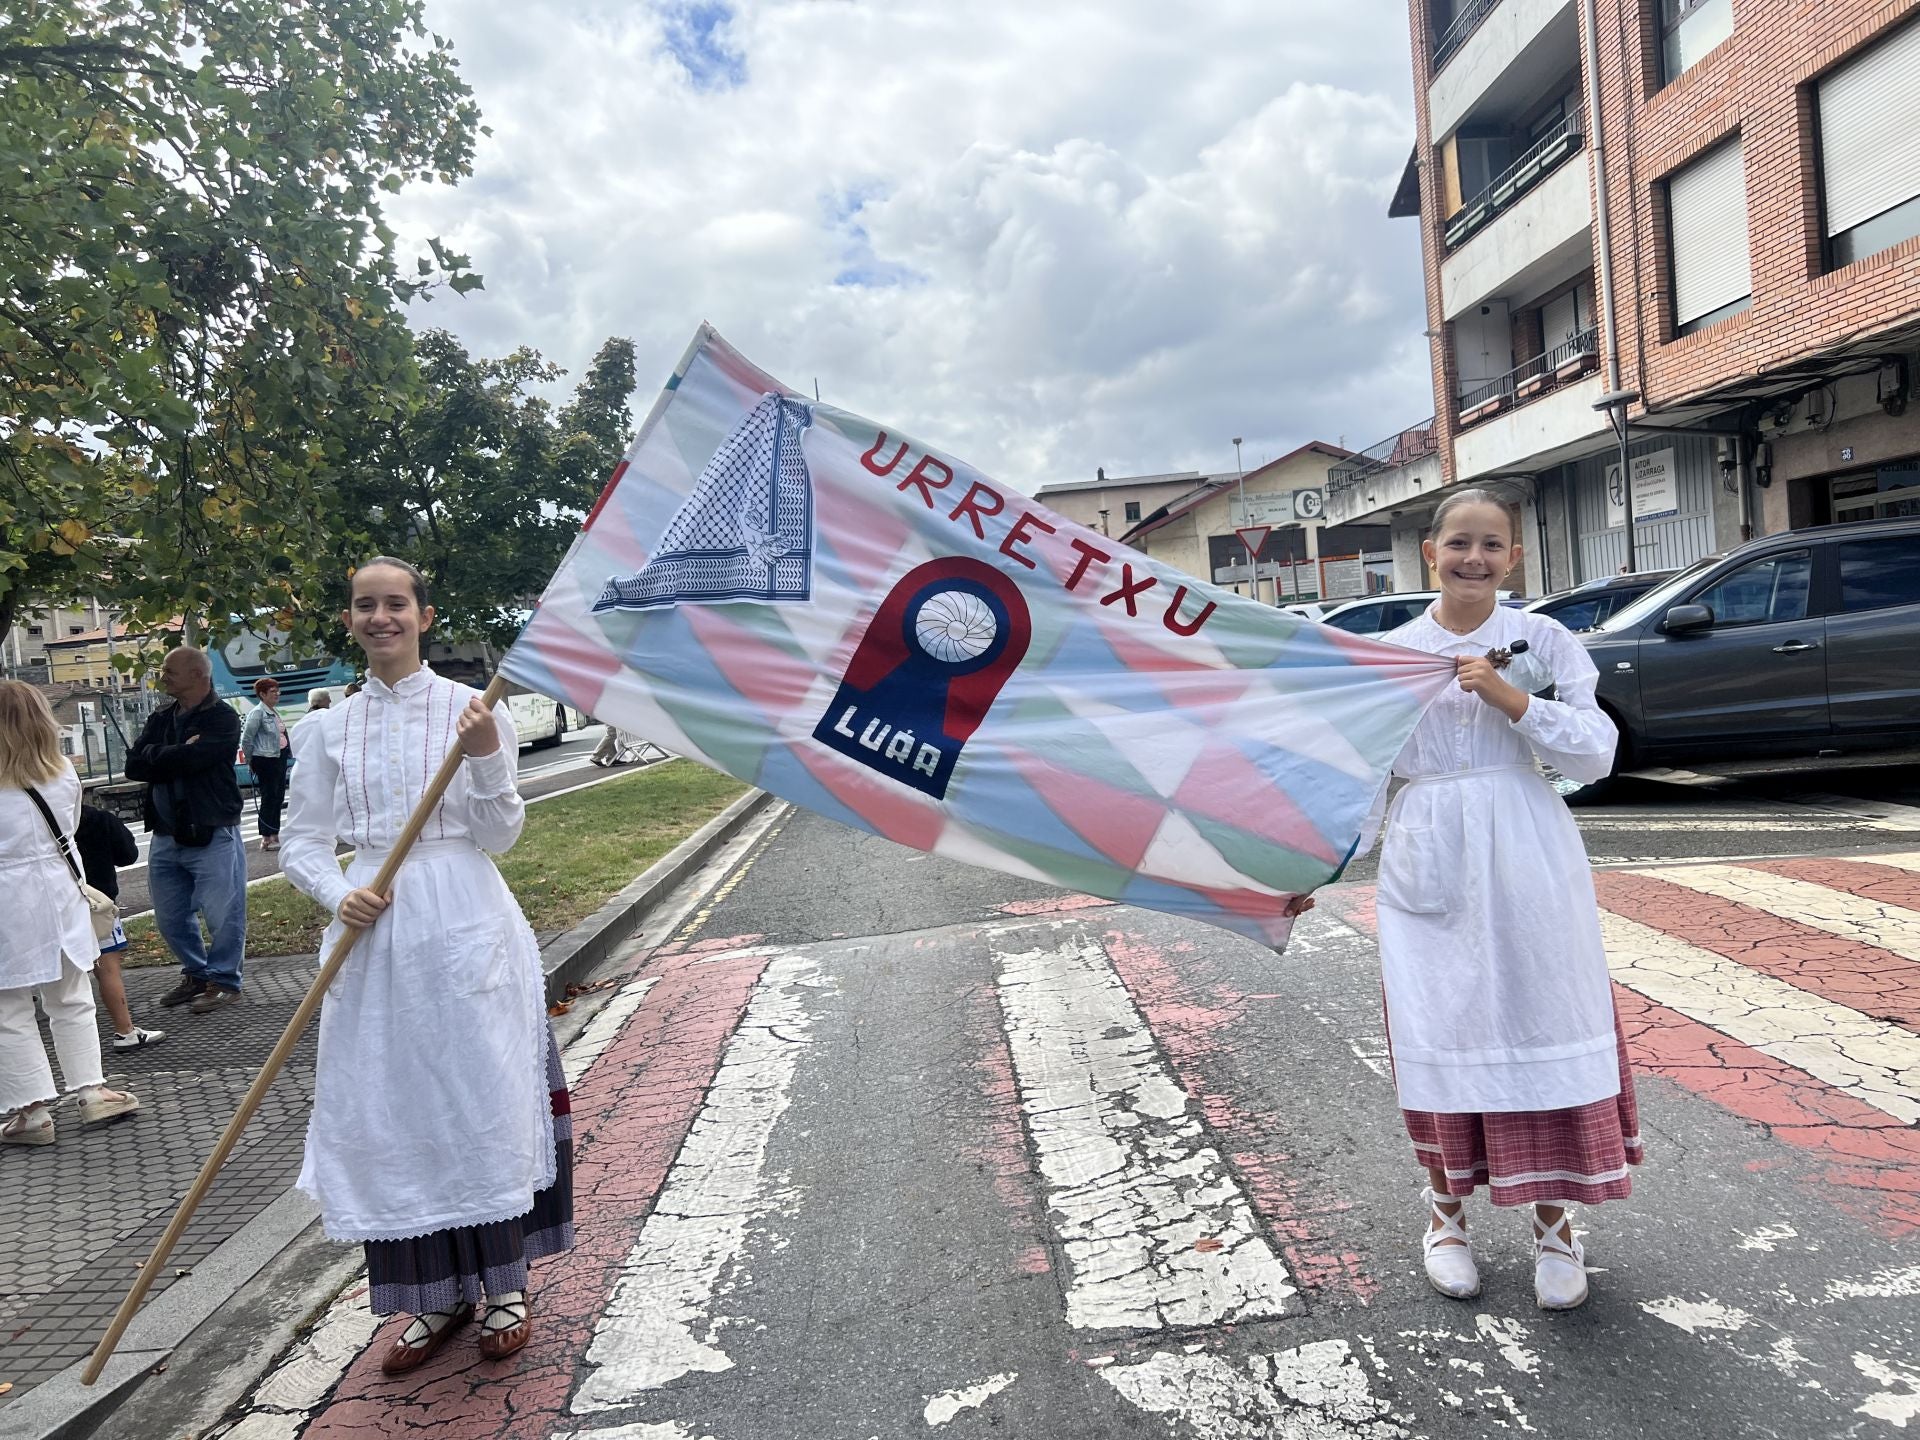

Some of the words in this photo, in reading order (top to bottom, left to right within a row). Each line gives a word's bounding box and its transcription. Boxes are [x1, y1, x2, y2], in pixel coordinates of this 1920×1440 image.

[1635, 458, 1650, 470] AITOR
[1635, 464, 1665, 479] LIZARRAGA
[860, 431, 1217, 637] URRETXU
